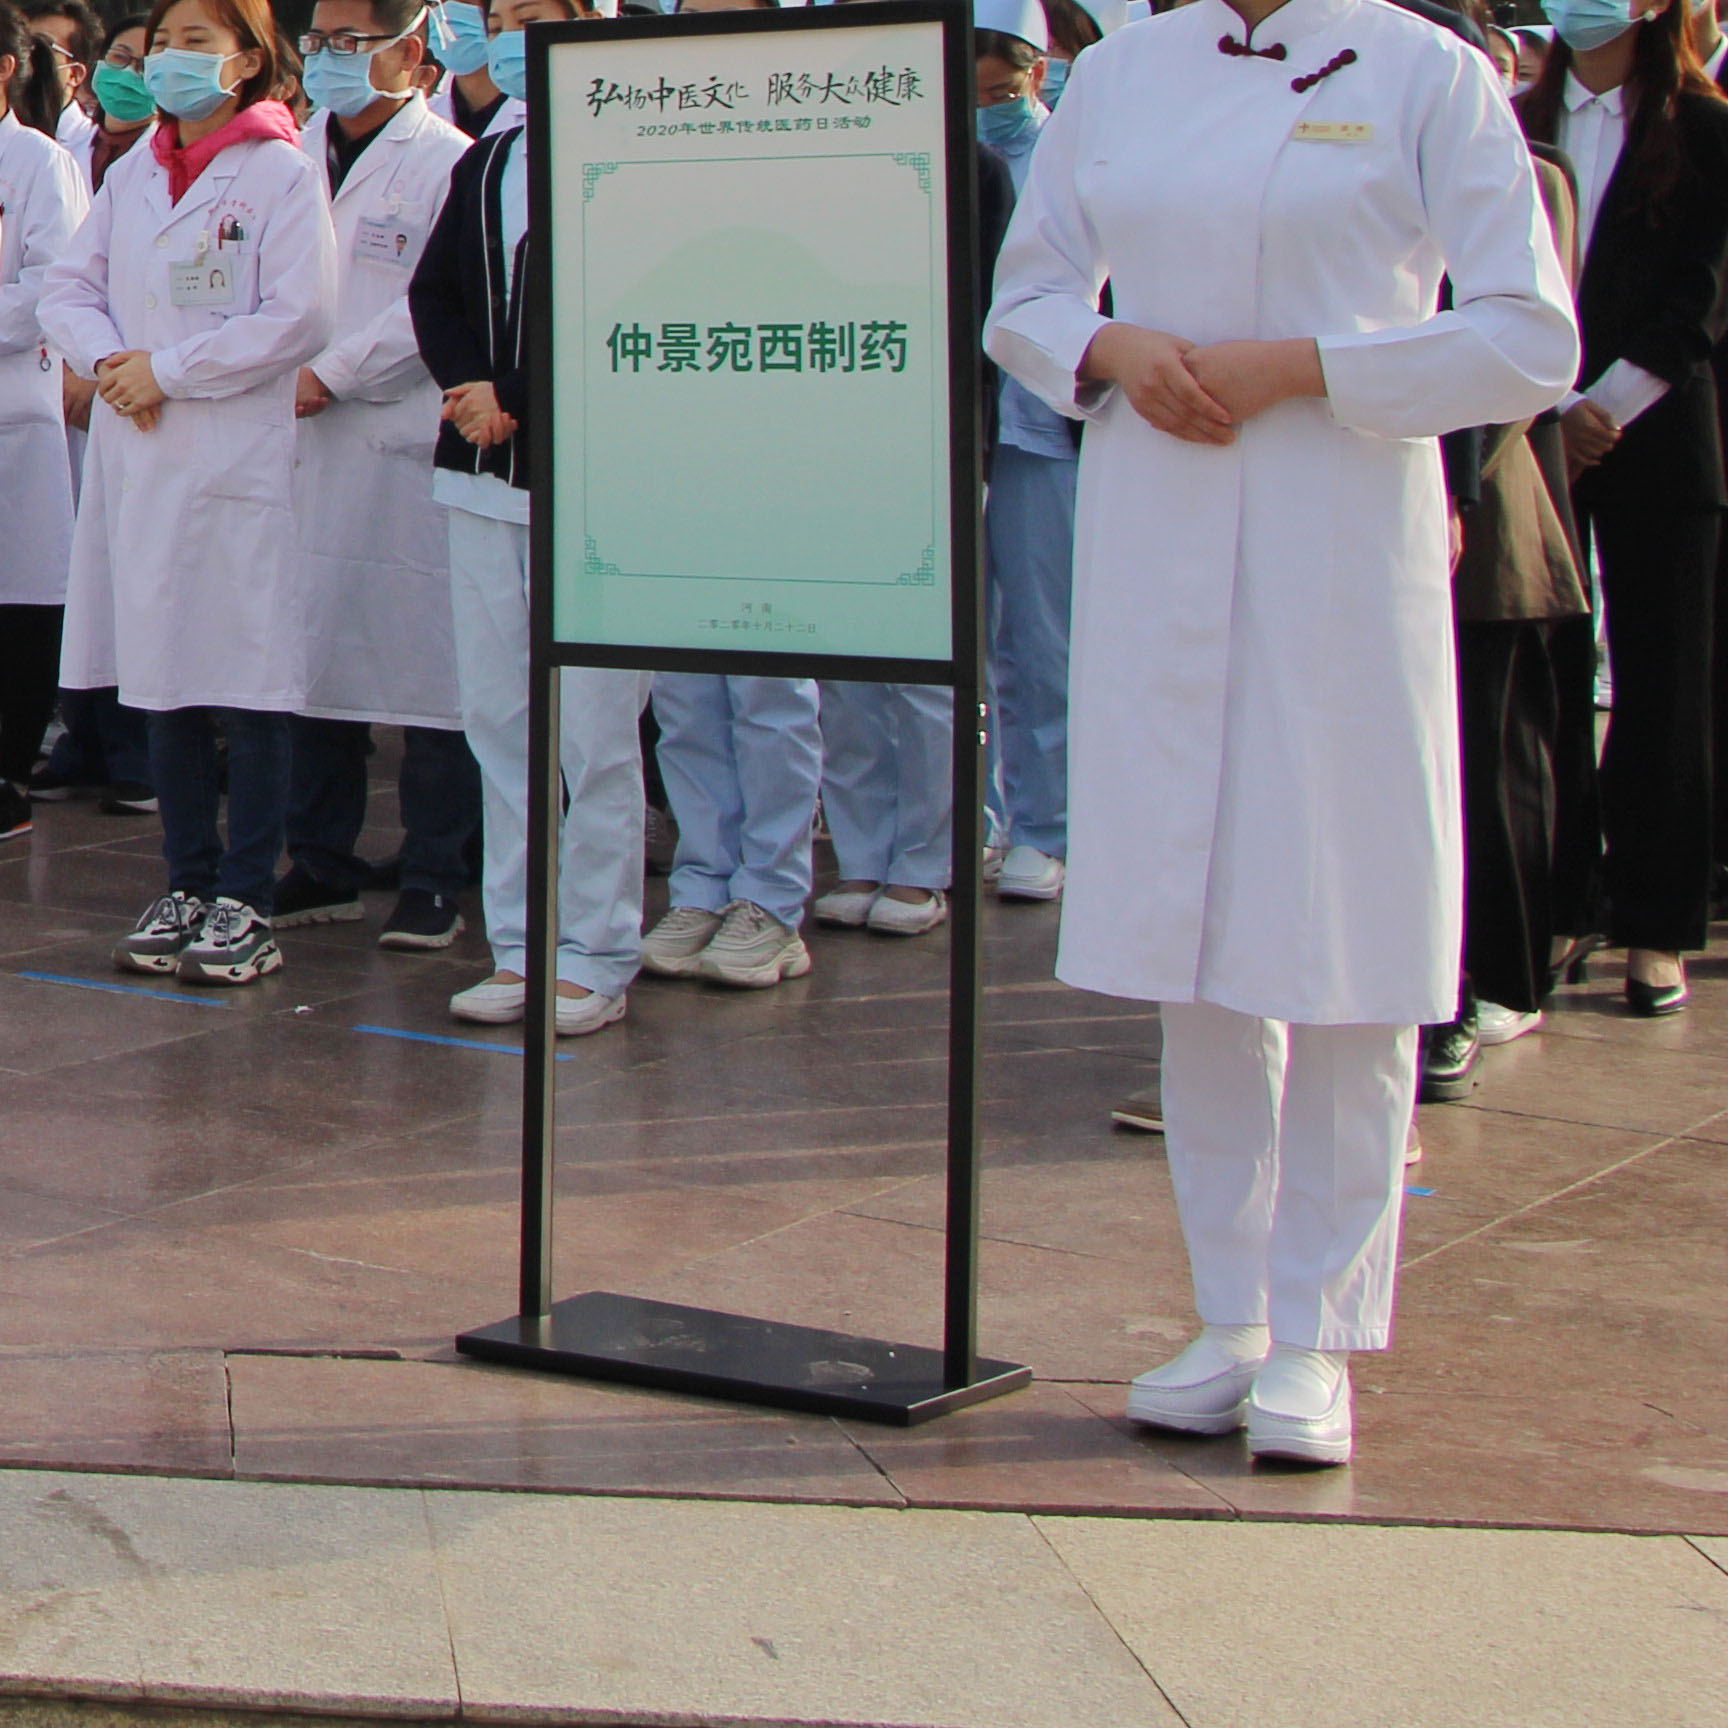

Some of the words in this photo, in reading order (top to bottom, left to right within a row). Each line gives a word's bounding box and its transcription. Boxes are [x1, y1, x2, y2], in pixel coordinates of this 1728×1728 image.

[586, 75, 750, 118] 弘扬中医文化
[766, 65, 926, 106] 服务大众健康
[636, 116, 872, 137] 2020年世界传统医药日活动
[606, 320, 909, 375] 仲景宛西制药
